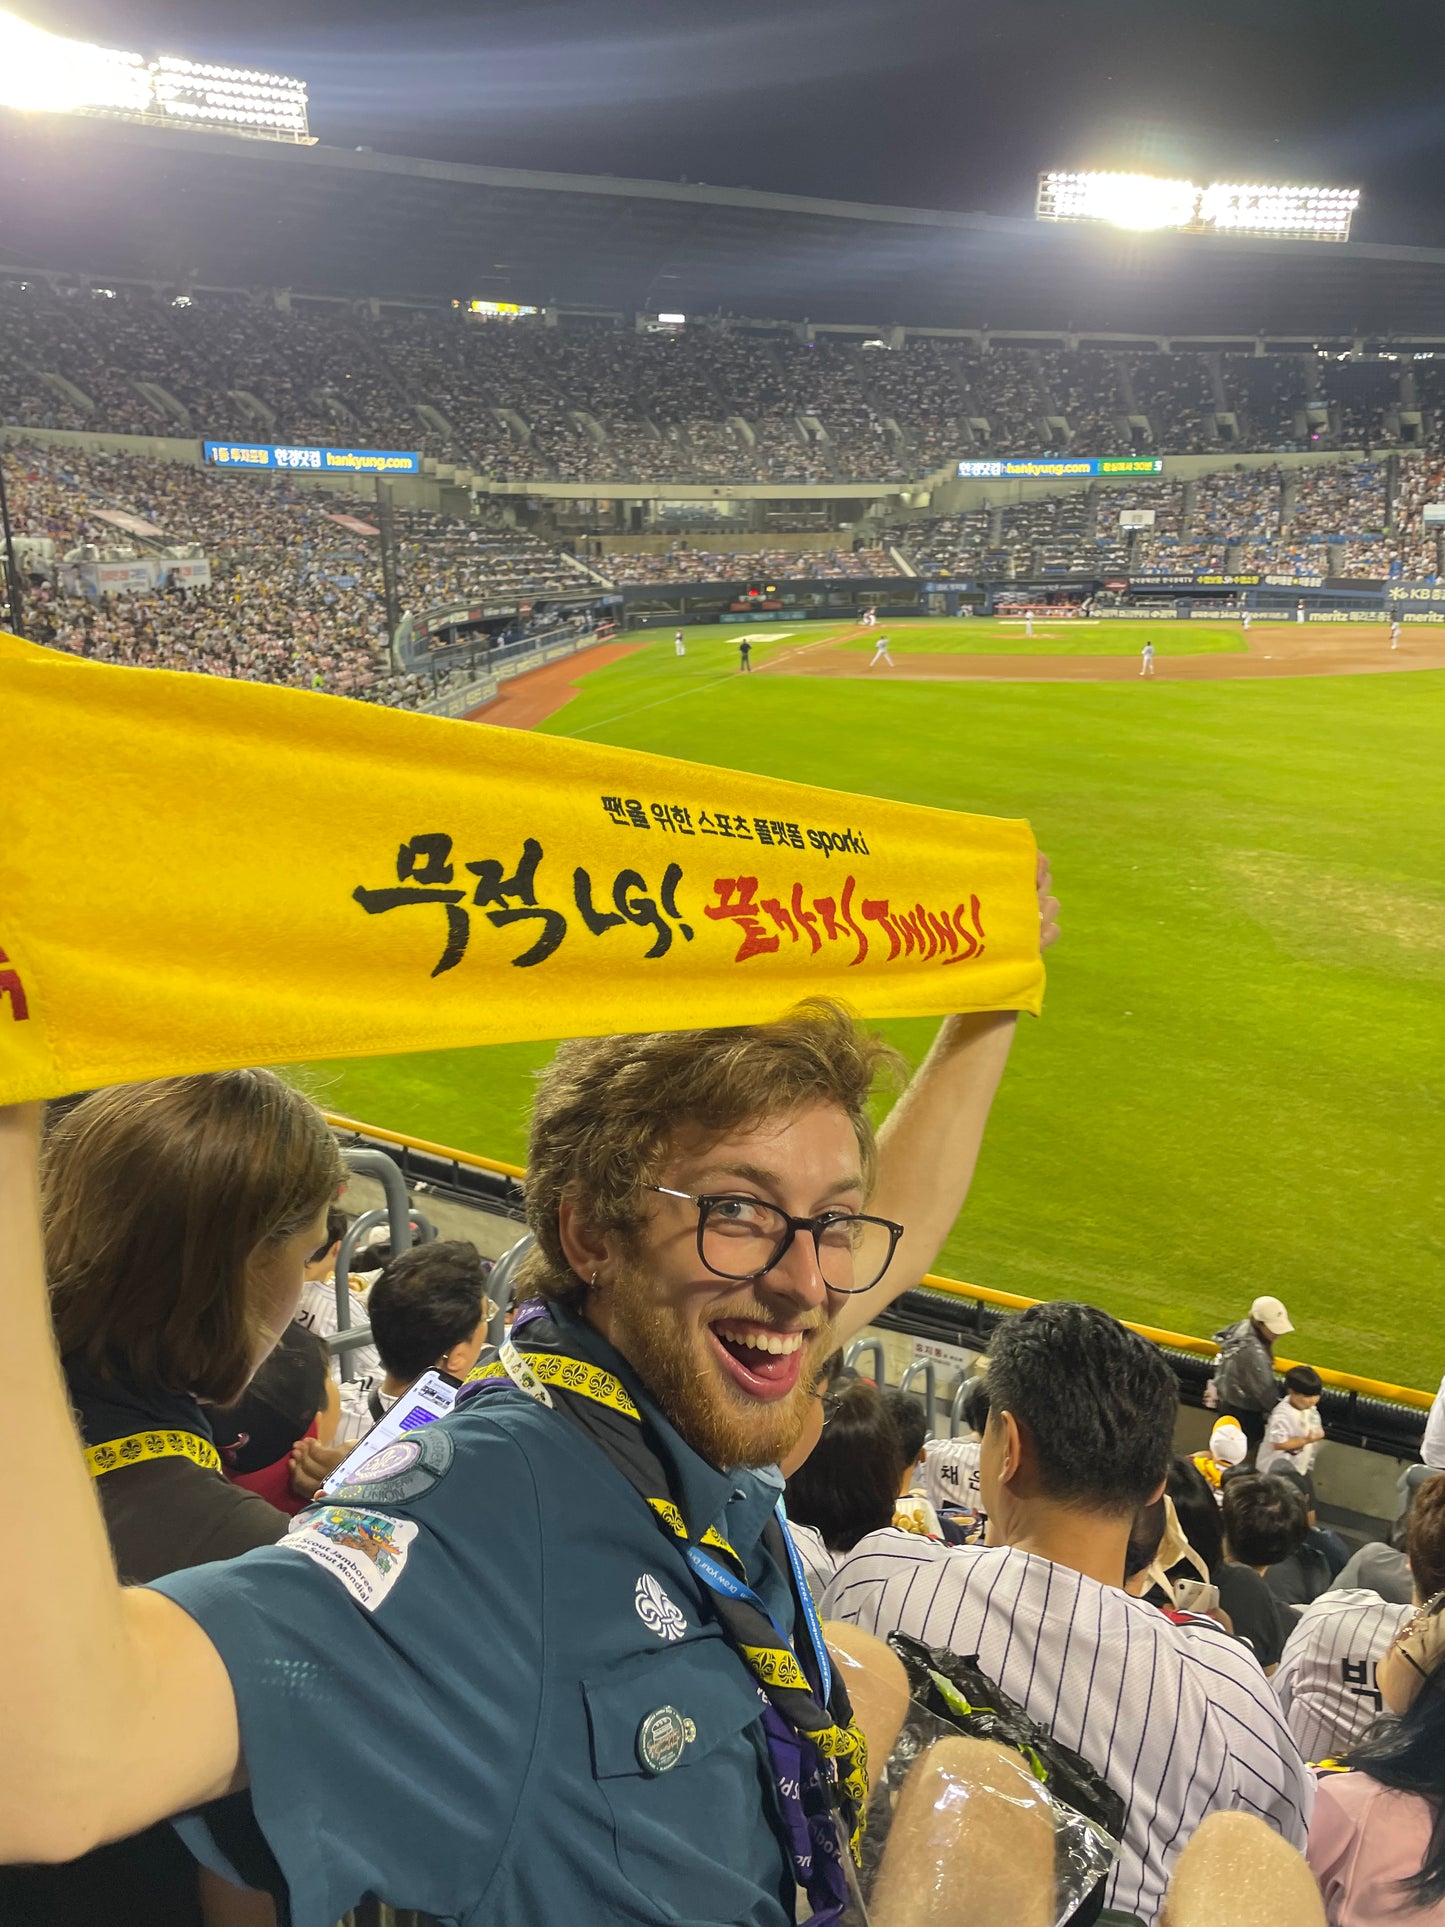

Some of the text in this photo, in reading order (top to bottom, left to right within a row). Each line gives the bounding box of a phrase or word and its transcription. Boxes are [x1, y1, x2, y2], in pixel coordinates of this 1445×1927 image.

[326, 452, 412, 470] hankyung.com
[1410, 588, 1431, 600] KB
[1309, 610, 1349, 622] meritz
[1403, 610, 1445, 623] meritz
[601, 796, 870, 858] 팬을 위한 스포츠 플랫폼 sporki
[353, 833, 985, 978] 무적 LG! 끝까지 TWINS!
[362, 1489, 406, 1502] UNION
[302, 1537, 331, 1552] Scout
[330, 1547, 374, 1593] Jamboree
[700, 1562, 719, 1578] your
[308, 1546, 370, 1603] Scout Mondial
[717, 1576, 738, 1594] Draw
[807, 1607, 824, 1651] Jamboree
